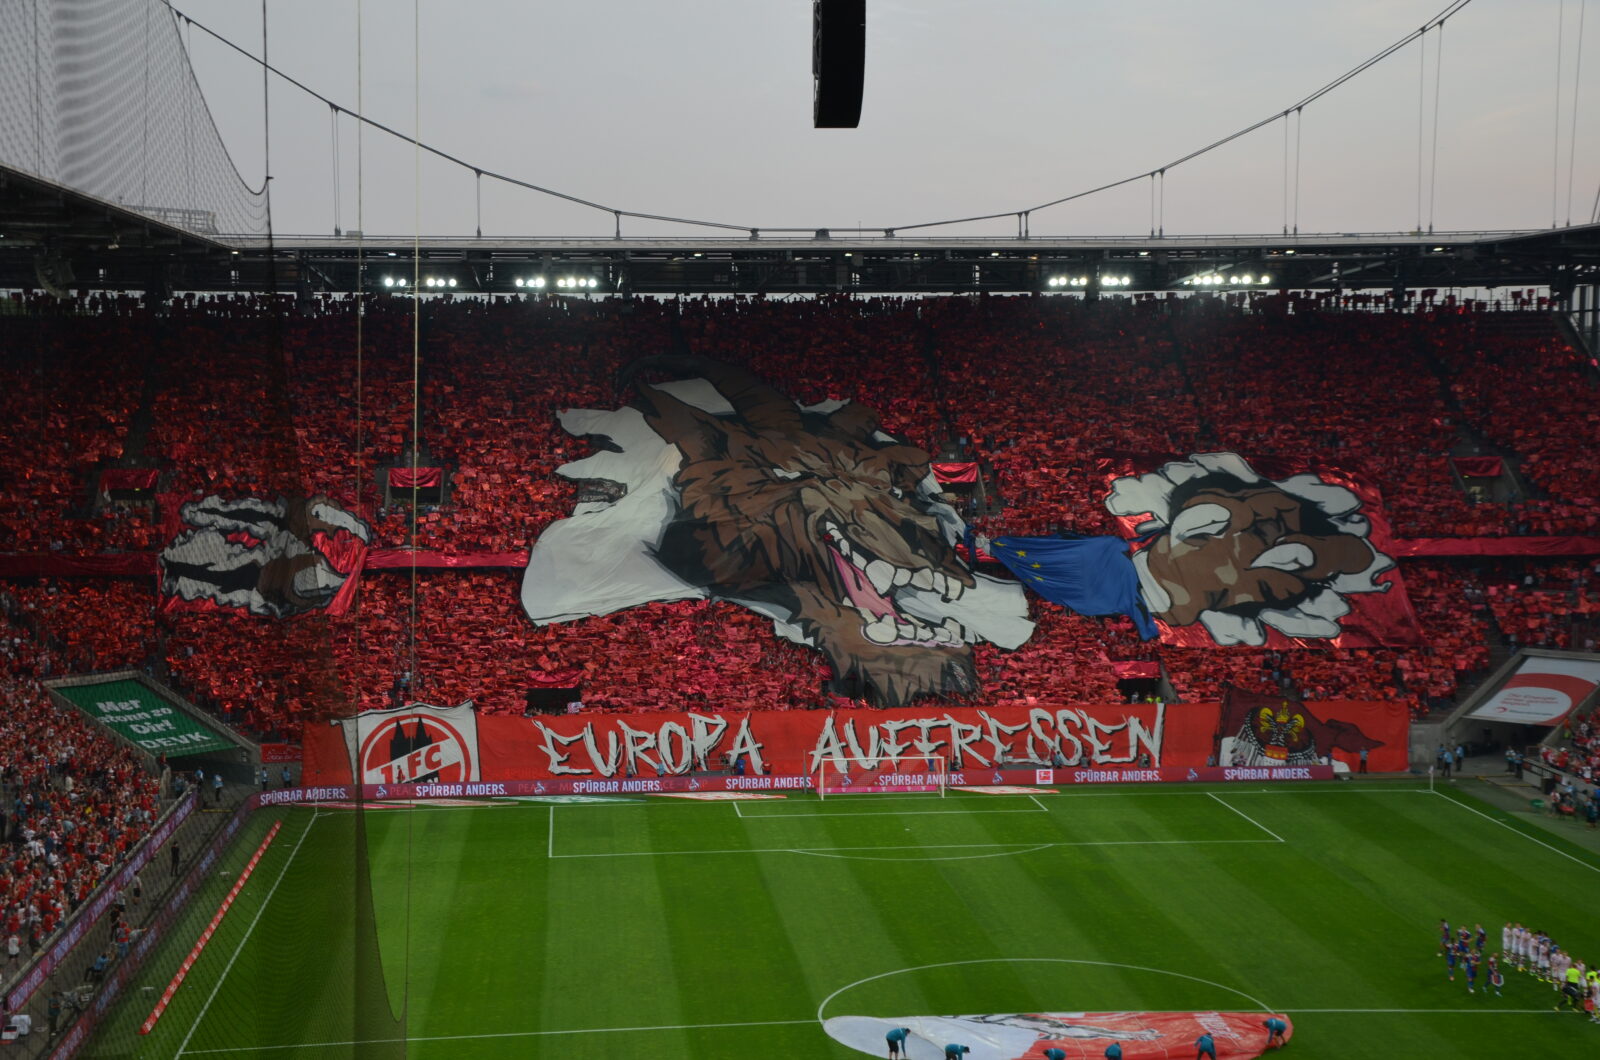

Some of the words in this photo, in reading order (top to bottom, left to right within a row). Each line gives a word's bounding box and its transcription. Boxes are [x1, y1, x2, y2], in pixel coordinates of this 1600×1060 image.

[95, 699, 141, 713] Mer
[129, 719, 177, 735] Dir!
[136, 731, 212, 749] DEVK
[532, 712, 764, 778] EUROPA
[810, 703, 1166, 774] AUFFRESSEN
[879, 773, 925, 786] SPÜRBAR
[1074, 769, 1119, 783] SPÜRBAR
[1121, 770, 1162, 782] ANDERS.
[1224, 767, 1269, 780] SPÜRBAR
[1271, 767, 1312, 780] ANDERS.
[416, 783, 463, 797] SPÜRBAR
[465, 783, 507, 796] ANDERS.
[573, 779, 619, 793] SPÜRBAR
[621, 779, 663, 792] ANDERS.
[725, 776, 771, 790] SPÜRBAR
[773, 776, 815, 789] ANDERS.
[260, 789, 302, 806] SPÜRBAR
[306, 787, 349, 801] ANDERS.
